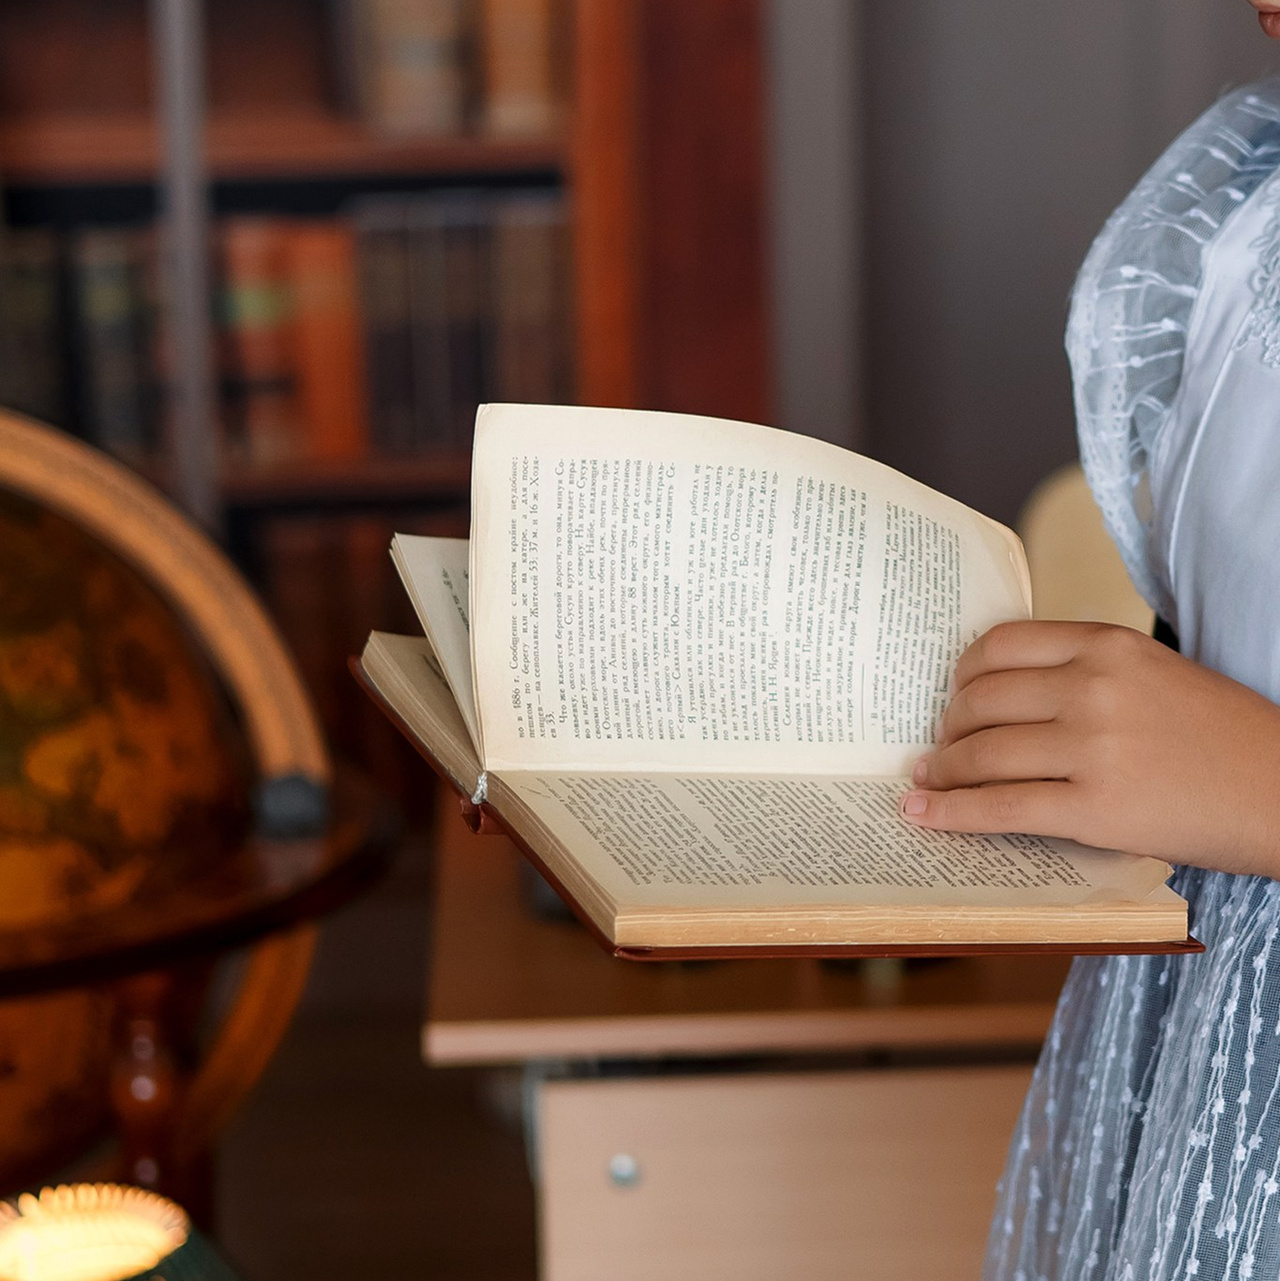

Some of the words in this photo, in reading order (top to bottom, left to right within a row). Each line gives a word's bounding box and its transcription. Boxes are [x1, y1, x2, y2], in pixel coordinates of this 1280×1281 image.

[530, 456, 539, 486] Хозя-
[556, 459, 564, 476] Со-
[568, 459, 576, 485] впра-
[577, 459, 587, 489] Сусуя
[602, 460, 610, 480] пря-
[632, 460, 642, 498] селений
[557, 479, 565, 510] минуя
[587, 460, 599, 514] впадающей
[689, 479, 700, 516] работал
[578, 492, 586, 520] карте
[632, 502, 640, 520] ряд
[509, 519, 518, 553] крайне
[567, 490, 575, 556] поворачивает
[629, 524, 638, 548] Этот
[597, 556, 605, 584] обеих
[530, 575, 538, 618] Жителей
[565, 595, 574, 626] Сусуи
[663, 575, 671, 617] которым
[554, 592, 564, 640] береговой
[578, 590, 586, 654] направлению
[588, 596, 596, 641] подходит
[599, 614, 607, 642] вдоль
[630, 604, 638, 633] длину
[641, 618, 649, 639] суть
[509, 615, 519, 670] Сообщение
[520, 642, 531, 675] берегу
[567, 630, 575, 657] устья
[608, 634, 617, 669] Анивы
[652, 631, 660, 667] служит
[589, 646, 599, 702] верховьями
[631, 648, 641, 695] имеющею
[642, 642, 650, 683] главную
[672, 639, 680, 680] Сахалин
[512, 688, 521, 709] 1886
[579, 673, 587, 692] уже
[622, 675, 630, 693] ряд
[653, 671, 663, 703] дорога
[687, 668, 696, 712] утомился
[558, 704, 567, 724] Что
[581, 694, 590, 716] идет
[600, 686, 611, 730] Охотское
[612, 688, 620, 718] линии
[621, 698, 634, 739] длинный
[526, 702, 535, 738] пешком
[537, 706, 547, 738] ленцев
[592, 706, 601, 740] своими
[613, 722, 622, 740] мой
[667, 719, 675, 740] ного
